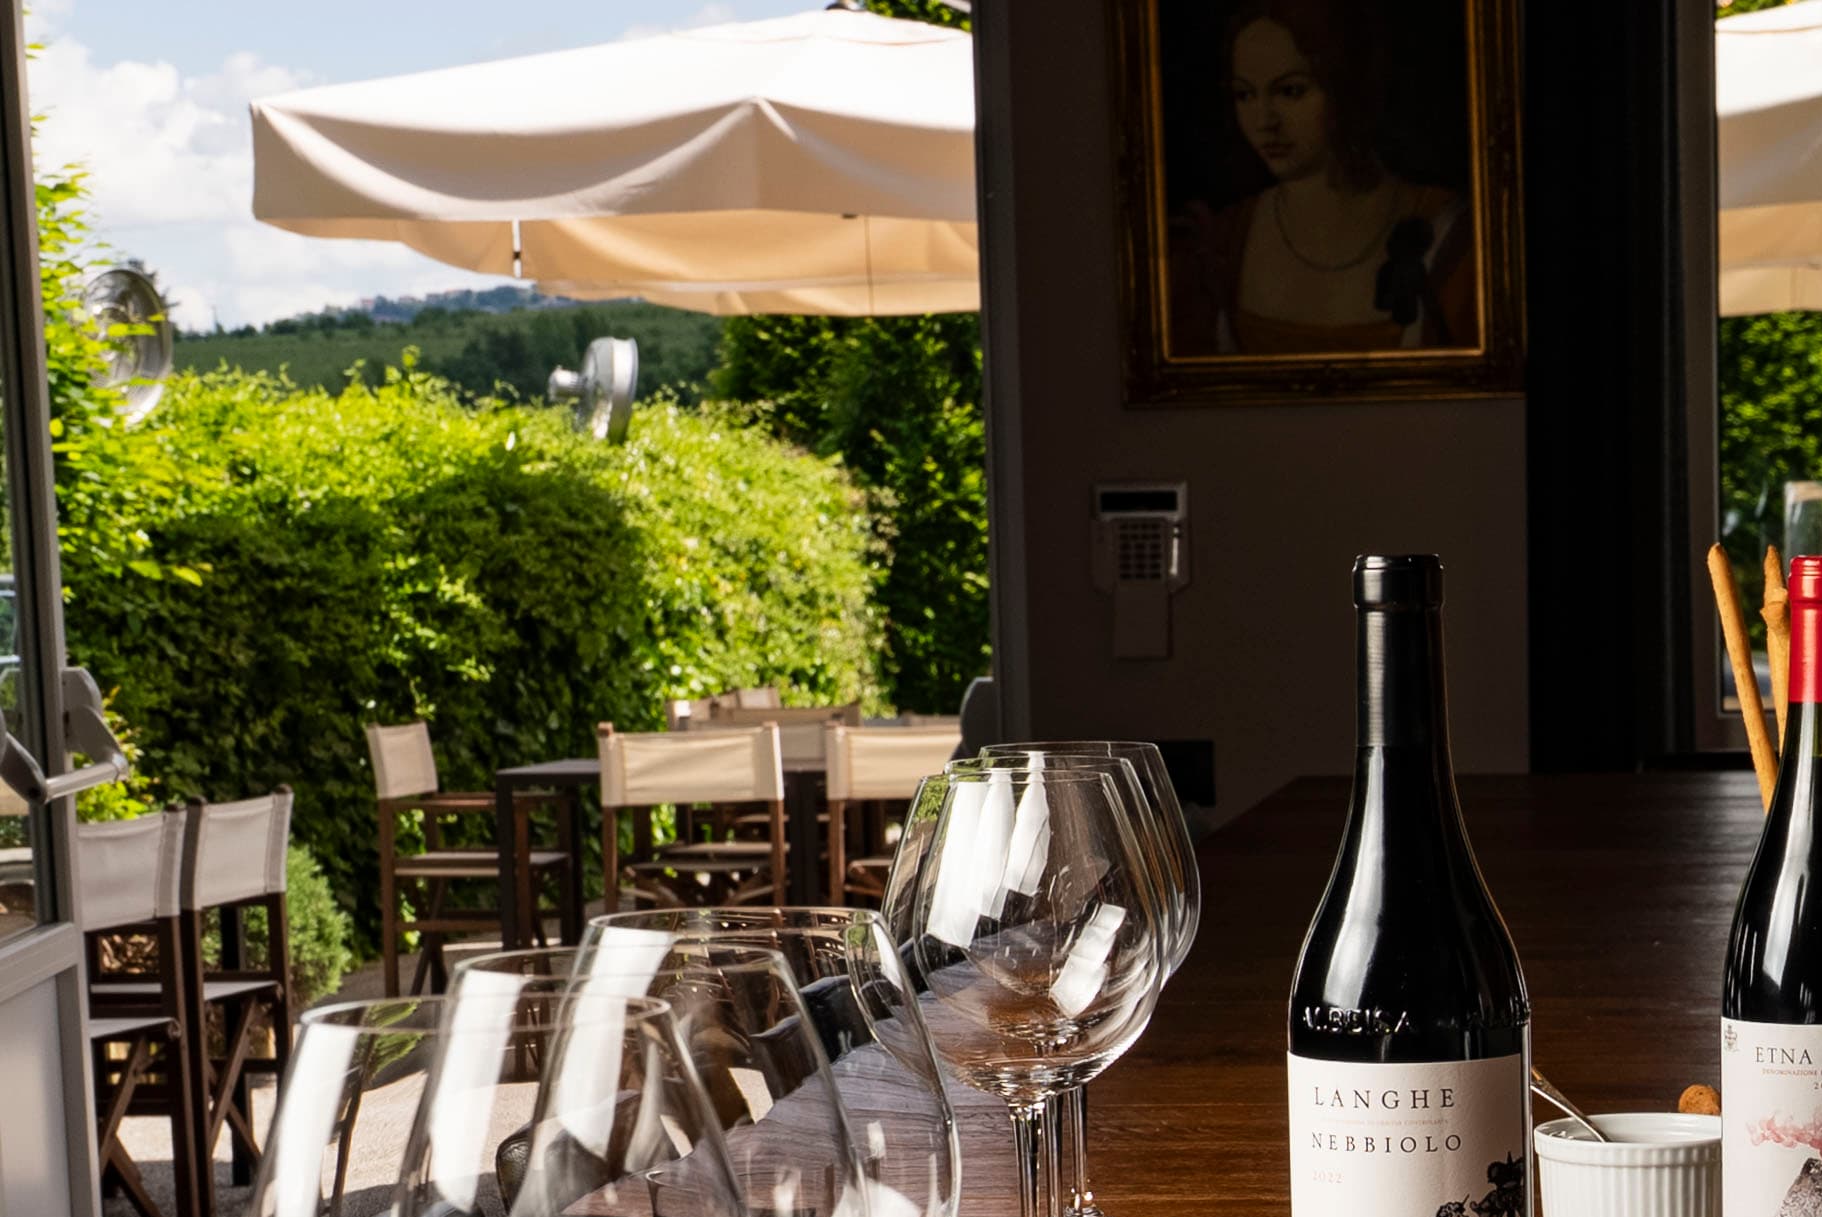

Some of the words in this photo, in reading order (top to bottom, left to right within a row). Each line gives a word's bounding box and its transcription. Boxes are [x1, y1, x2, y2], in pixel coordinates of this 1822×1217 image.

[1755, 1046, 1813, 1065] ETNA
[1314, 1086, 1455, 1110] LANGHE
[1312, 1132, 1462, 1154] NEBBIOLO
